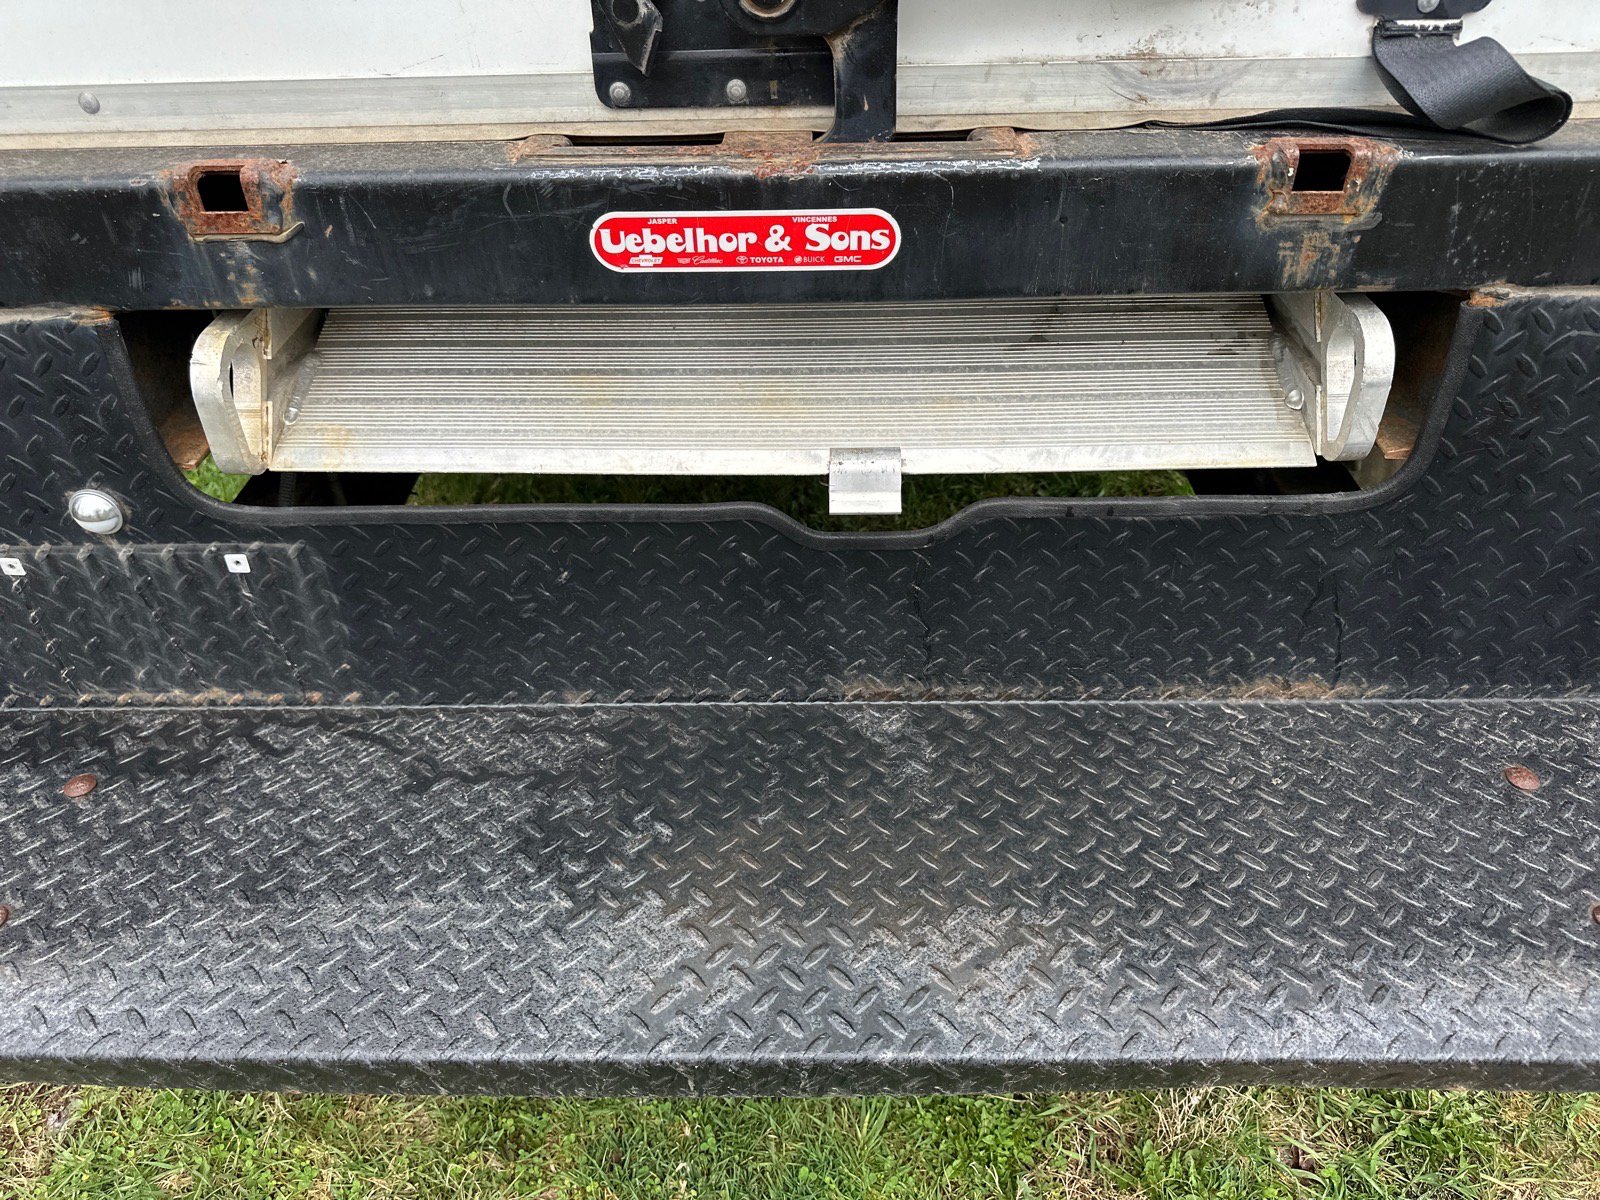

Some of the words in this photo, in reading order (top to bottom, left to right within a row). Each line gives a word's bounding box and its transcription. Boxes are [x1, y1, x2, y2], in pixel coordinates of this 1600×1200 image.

[647, 217, 678, 225] JASPER
[598, 227, 758, 254] Uebelhor
[764, 224, 792, 253] &
[804, 223, 891, 252] Sons
[749, 256, 784, 264] TOYOTA
[834, 255, 862, 263] GMC
